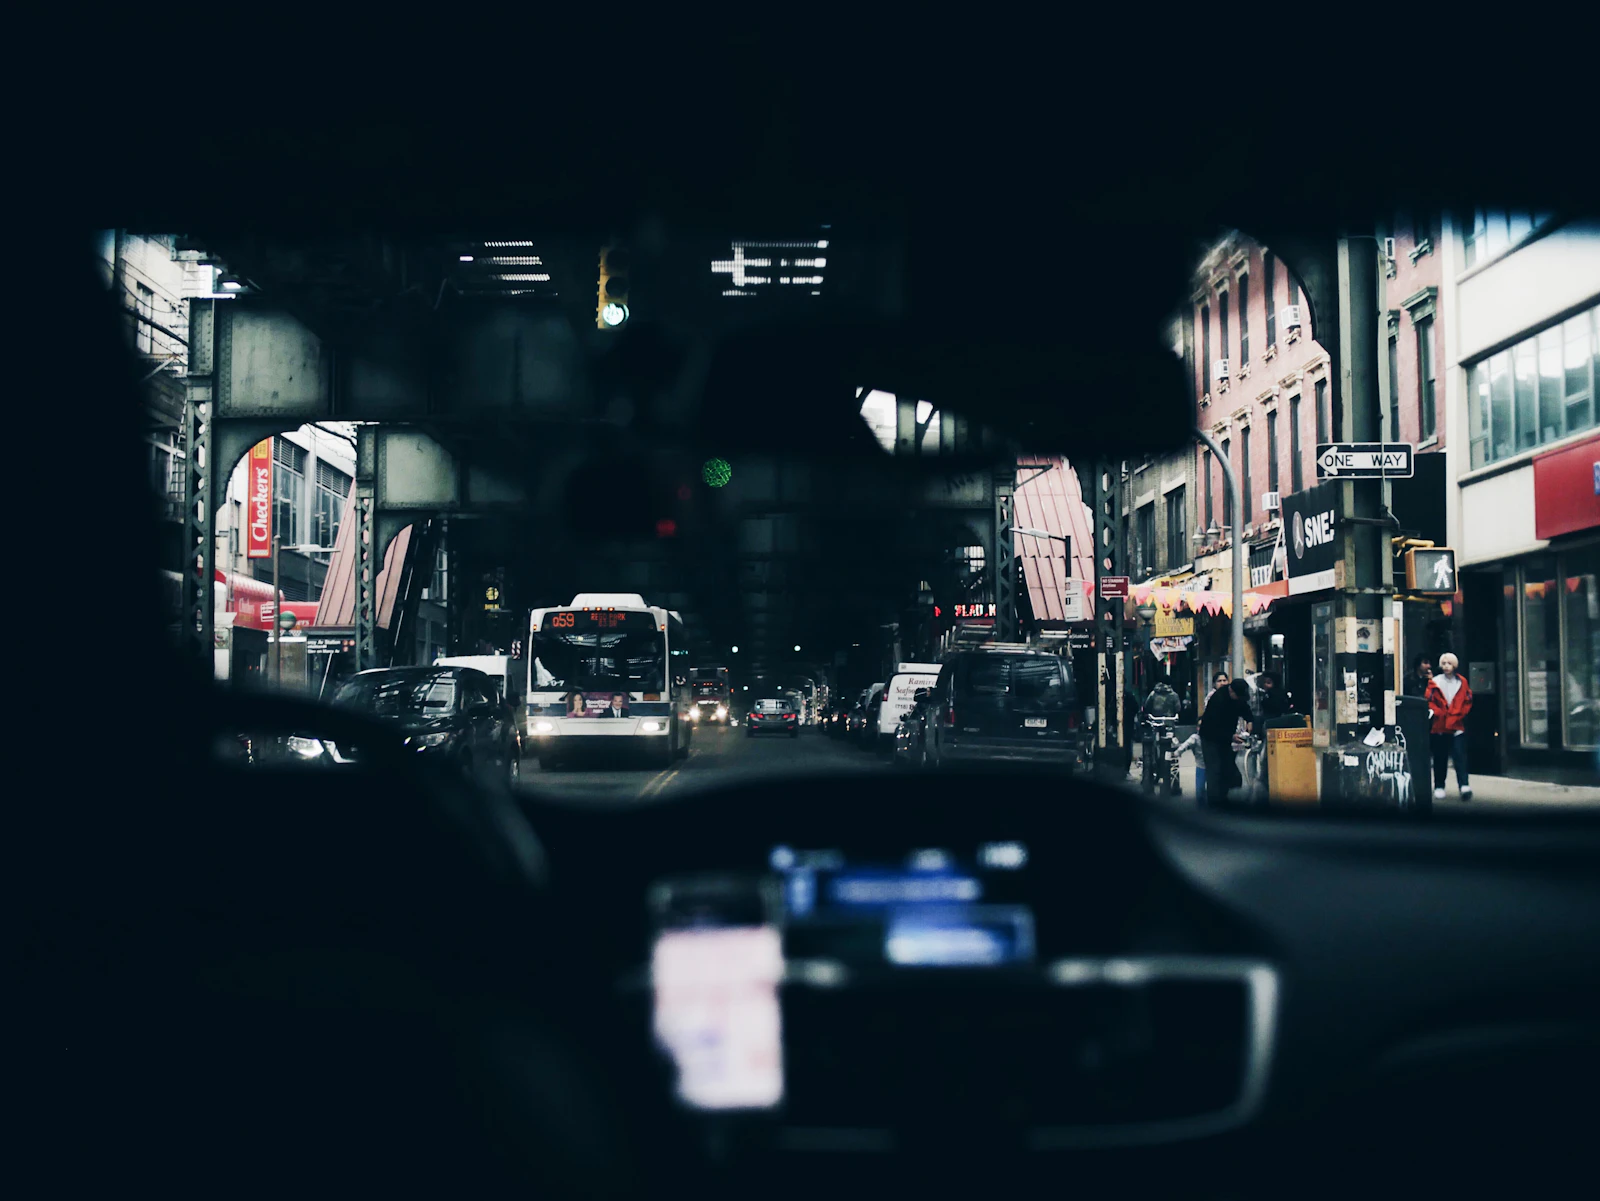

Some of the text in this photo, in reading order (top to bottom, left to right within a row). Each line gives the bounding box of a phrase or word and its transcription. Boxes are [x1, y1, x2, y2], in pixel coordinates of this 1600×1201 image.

[1324, 454, 1403, 467] ONE WAY
[252, 467, 269, 542] Checkers
[907, 677, 936, 686] Ramire
[895, 686, 916, 696] Seafoo
